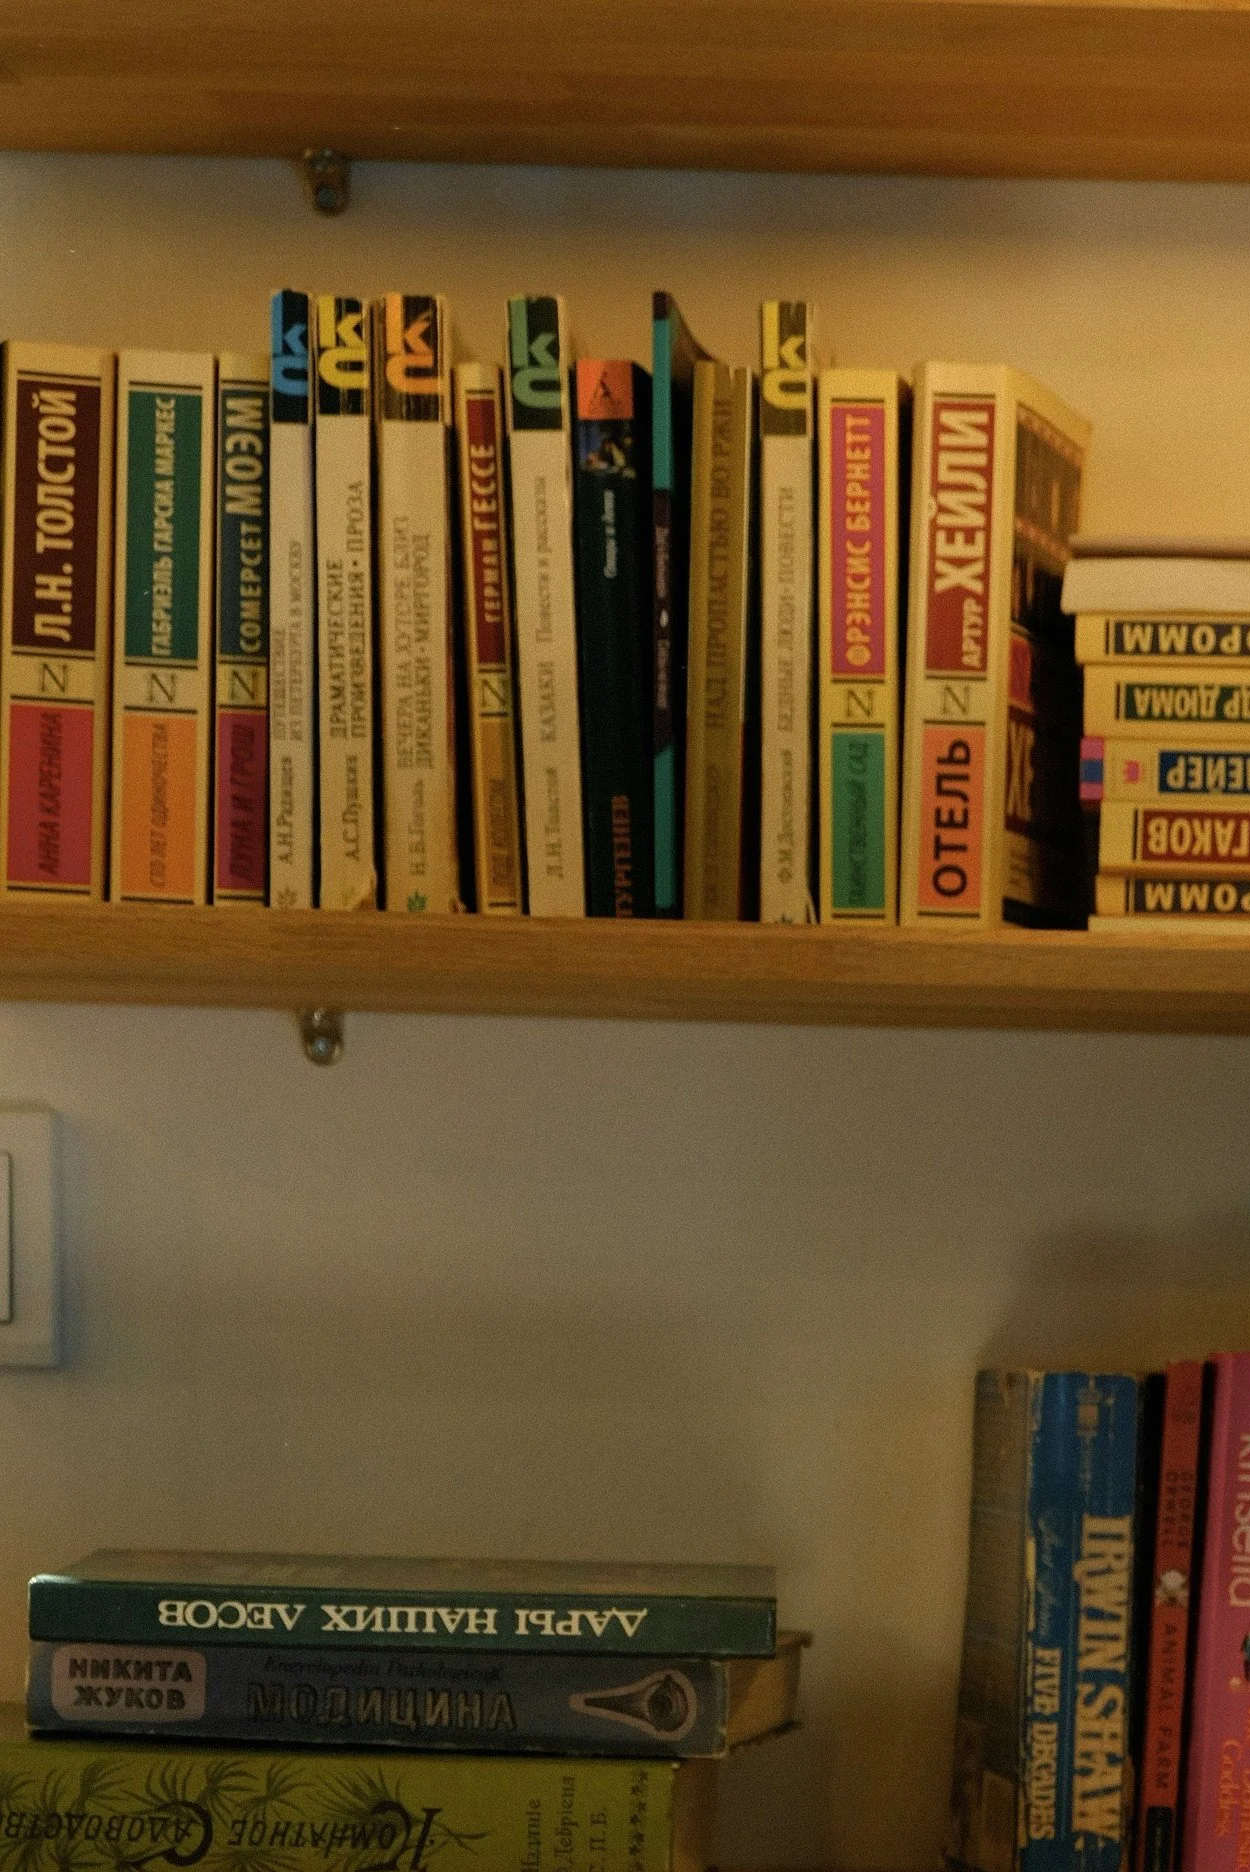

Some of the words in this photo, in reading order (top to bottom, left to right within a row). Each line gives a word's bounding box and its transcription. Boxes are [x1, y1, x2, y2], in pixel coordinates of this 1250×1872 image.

[30, 391, 77, 554] ТОЛСТОЙ
[152, 397, 177, 477] МАРКЕС
[225, 397, 263, 517] МОЭМ
[843, 413, 872, 532] БЕРНЕТТ
[347, 480, 364, 554] ПРОЗА
[470, 443, 497, 532] ГЕССЕ
[926, 408, 988, 595] ХЕЙЛИ
[34, 562, 75, 642] Л.Н.
[236, 522, 263, 652] СОМЕРСЕТ
[844, 539, 873, 667] ФРЭНСИС
[326, 558, 347, 739] ДРАМАТИЧЕСКИЕ
[961, 597, 983, 668] АРТУР
[536, 661, 558, 743] КАЗАКИ
[1133, 683, 1222, 721] ДЮМА
[37, 712, 64, 816] КАРЕНИНА
[37, 819, 62, 876] АННА
[931, 739, 972, 899] ОТЕЛЬ
[157, 1600, 306, 1632] ЛЕСОВ
[320, 1604, 498, 1635] НАШИХ
[512, 1608, 648, 1638] ДАРЫ
[1072, 1512, 1133, 1673] IRWIN
[68, 1657, 194, 1682] НИКИТА
[74, 1685, 188, 1710] ЖУКОВ
[246, 1681, 519, 1732] МОДИЦИНА
[1034, 1647, 1063, 1716] FIVE
[1157, 1621, 1179, 1714] ANIMAL
[1029, 1721, 1058, 1841] DECADES
[1071, 1683, 1125, 1850] SHAW
[1155, 1725, 1176, 1790] FARM
